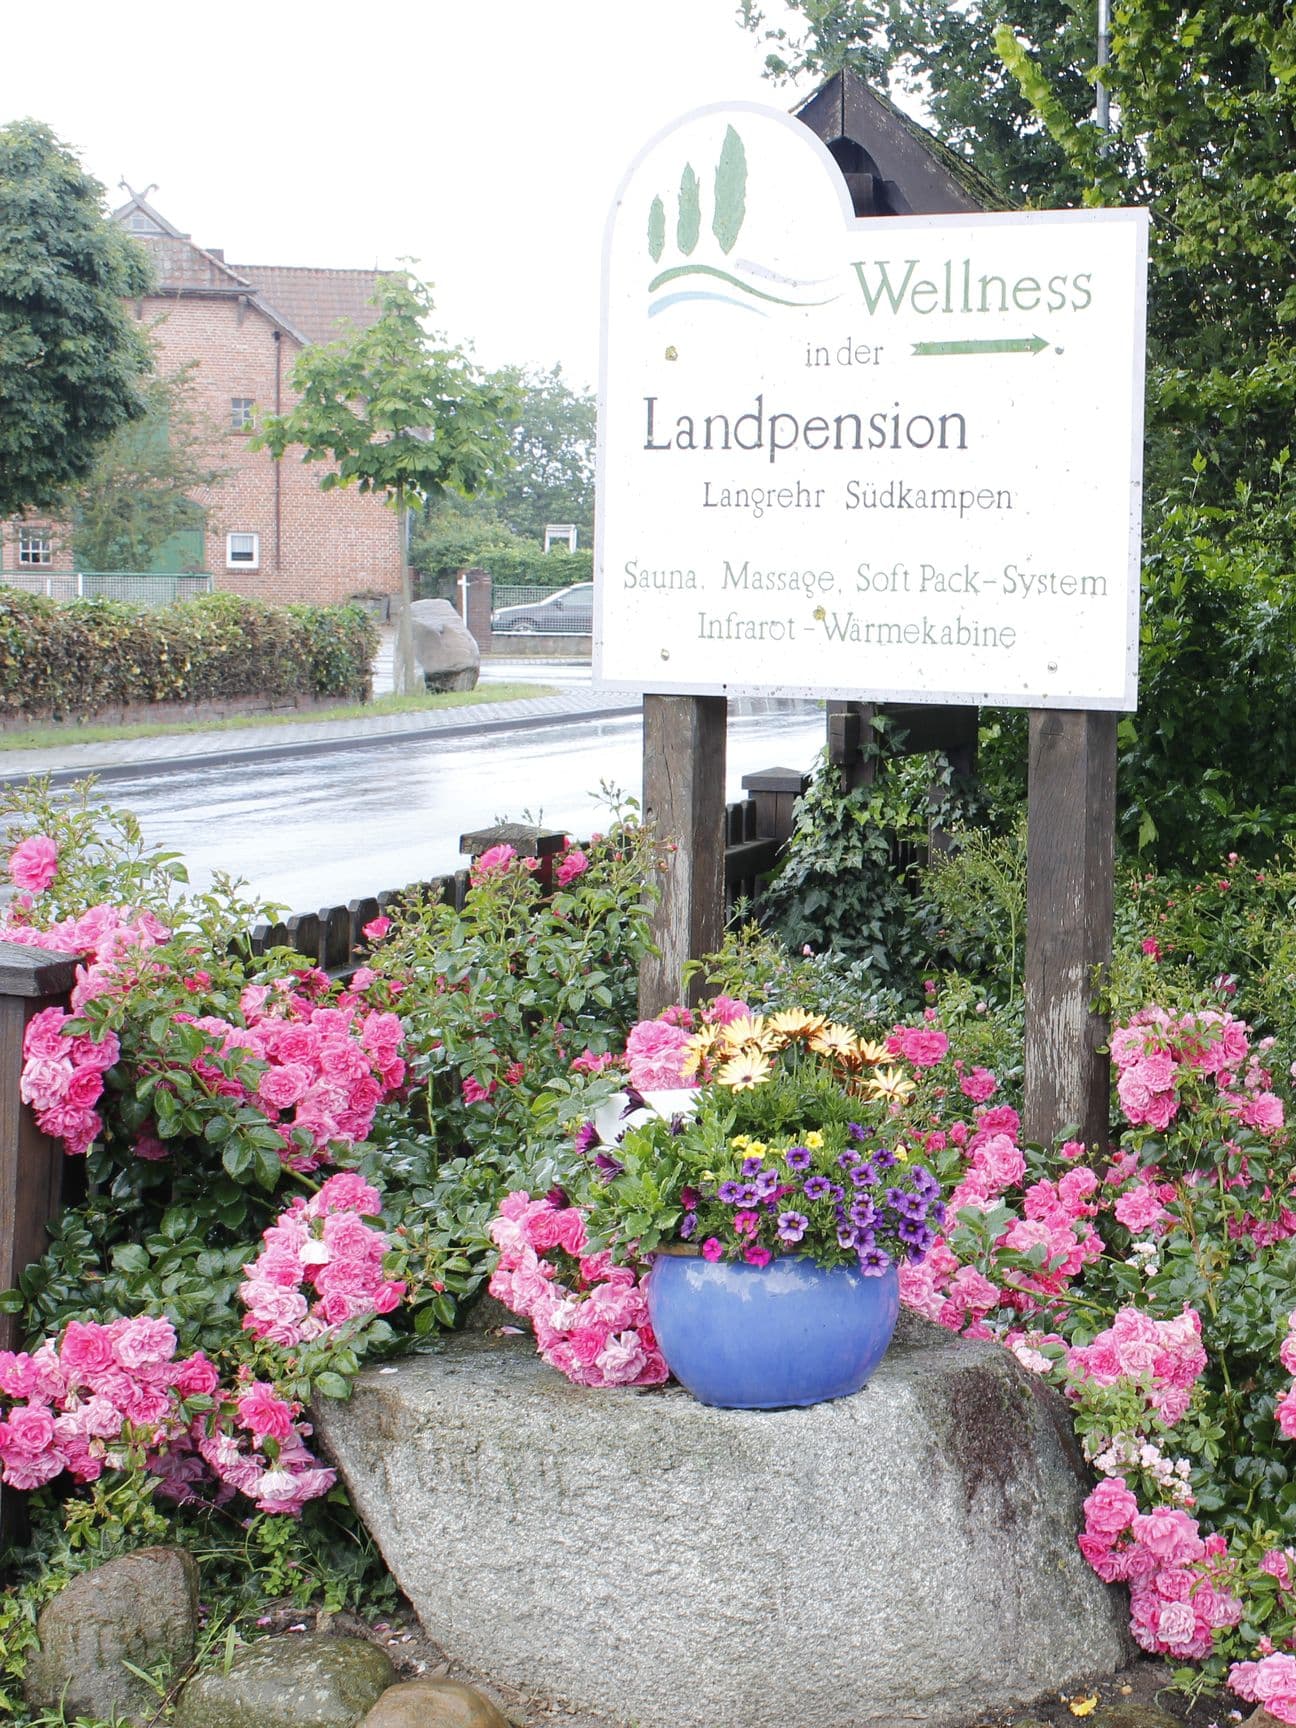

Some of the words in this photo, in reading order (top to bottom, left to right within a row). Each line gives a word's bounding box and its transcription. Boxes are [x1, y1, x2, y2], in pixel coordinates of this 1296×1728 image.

[850, 259, 1092, 316] Wellness
[805, 341, 831, 367] in
[836, 336, 884, 366] der
[643, 394, 968, 463] Landpension
[703, 481, 825, 518] Langrehr
[845, 480, 1013, 518] Südkampen
[857, 562, 911, 593] Soft
